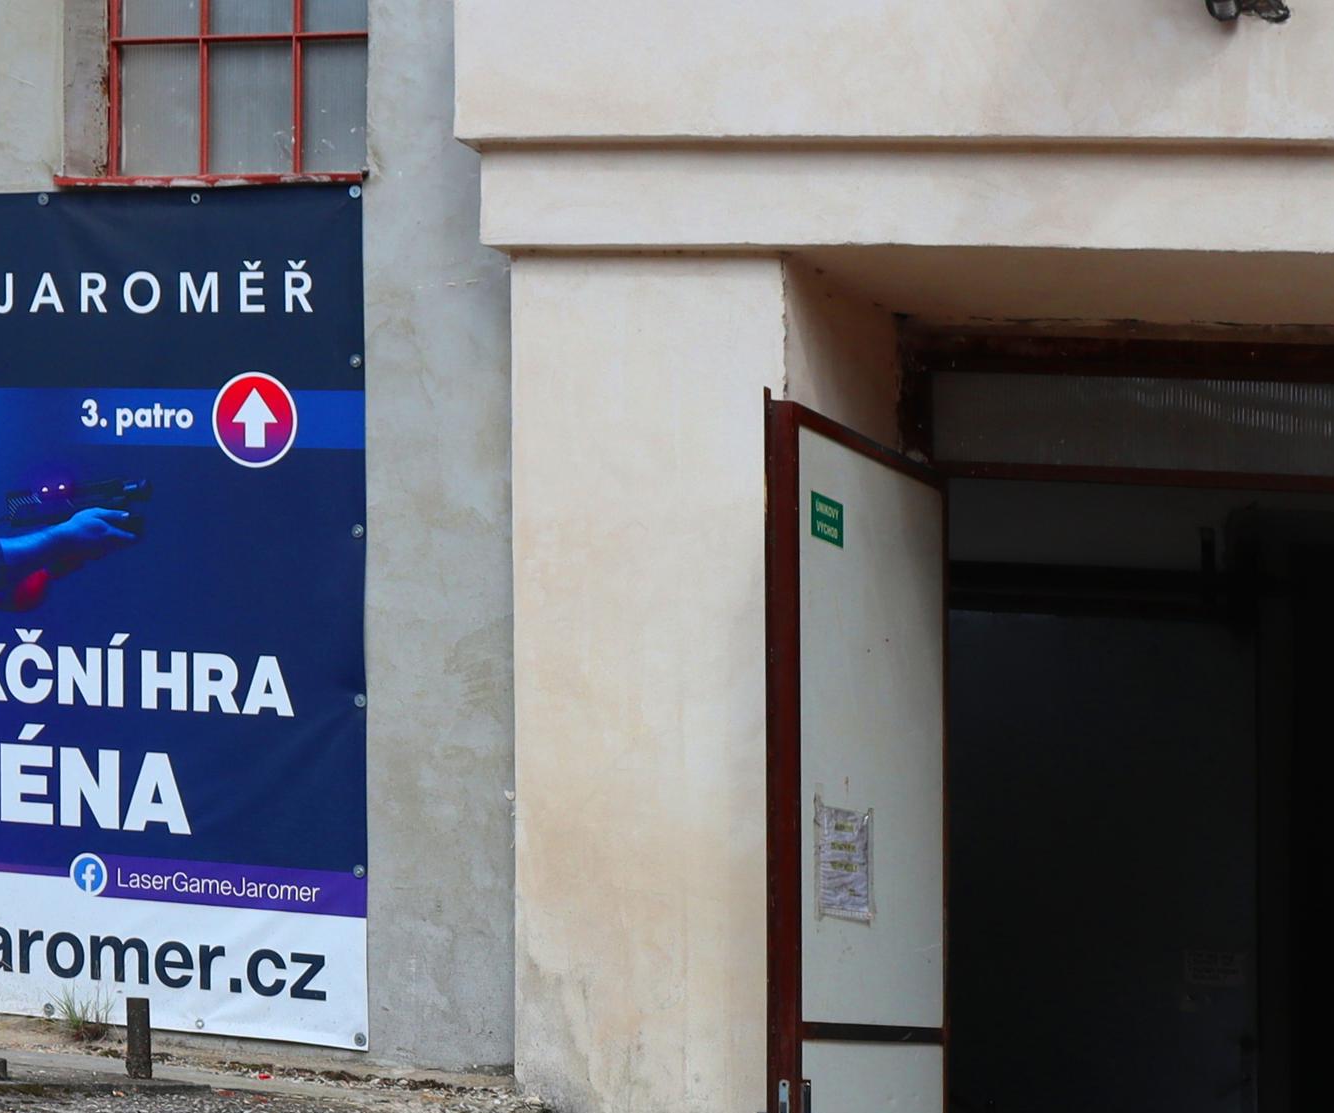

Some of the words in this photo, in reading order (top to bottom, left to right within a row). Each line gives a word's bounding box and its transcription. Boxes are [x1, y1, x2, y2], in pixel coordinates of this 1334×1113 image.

[81, 399, 108, 427] 3.
[116, 403, 194, 436] patro
[140, 648, 296, 718] HRA
[117, 867, 321, 904] LaserGameJaromer
